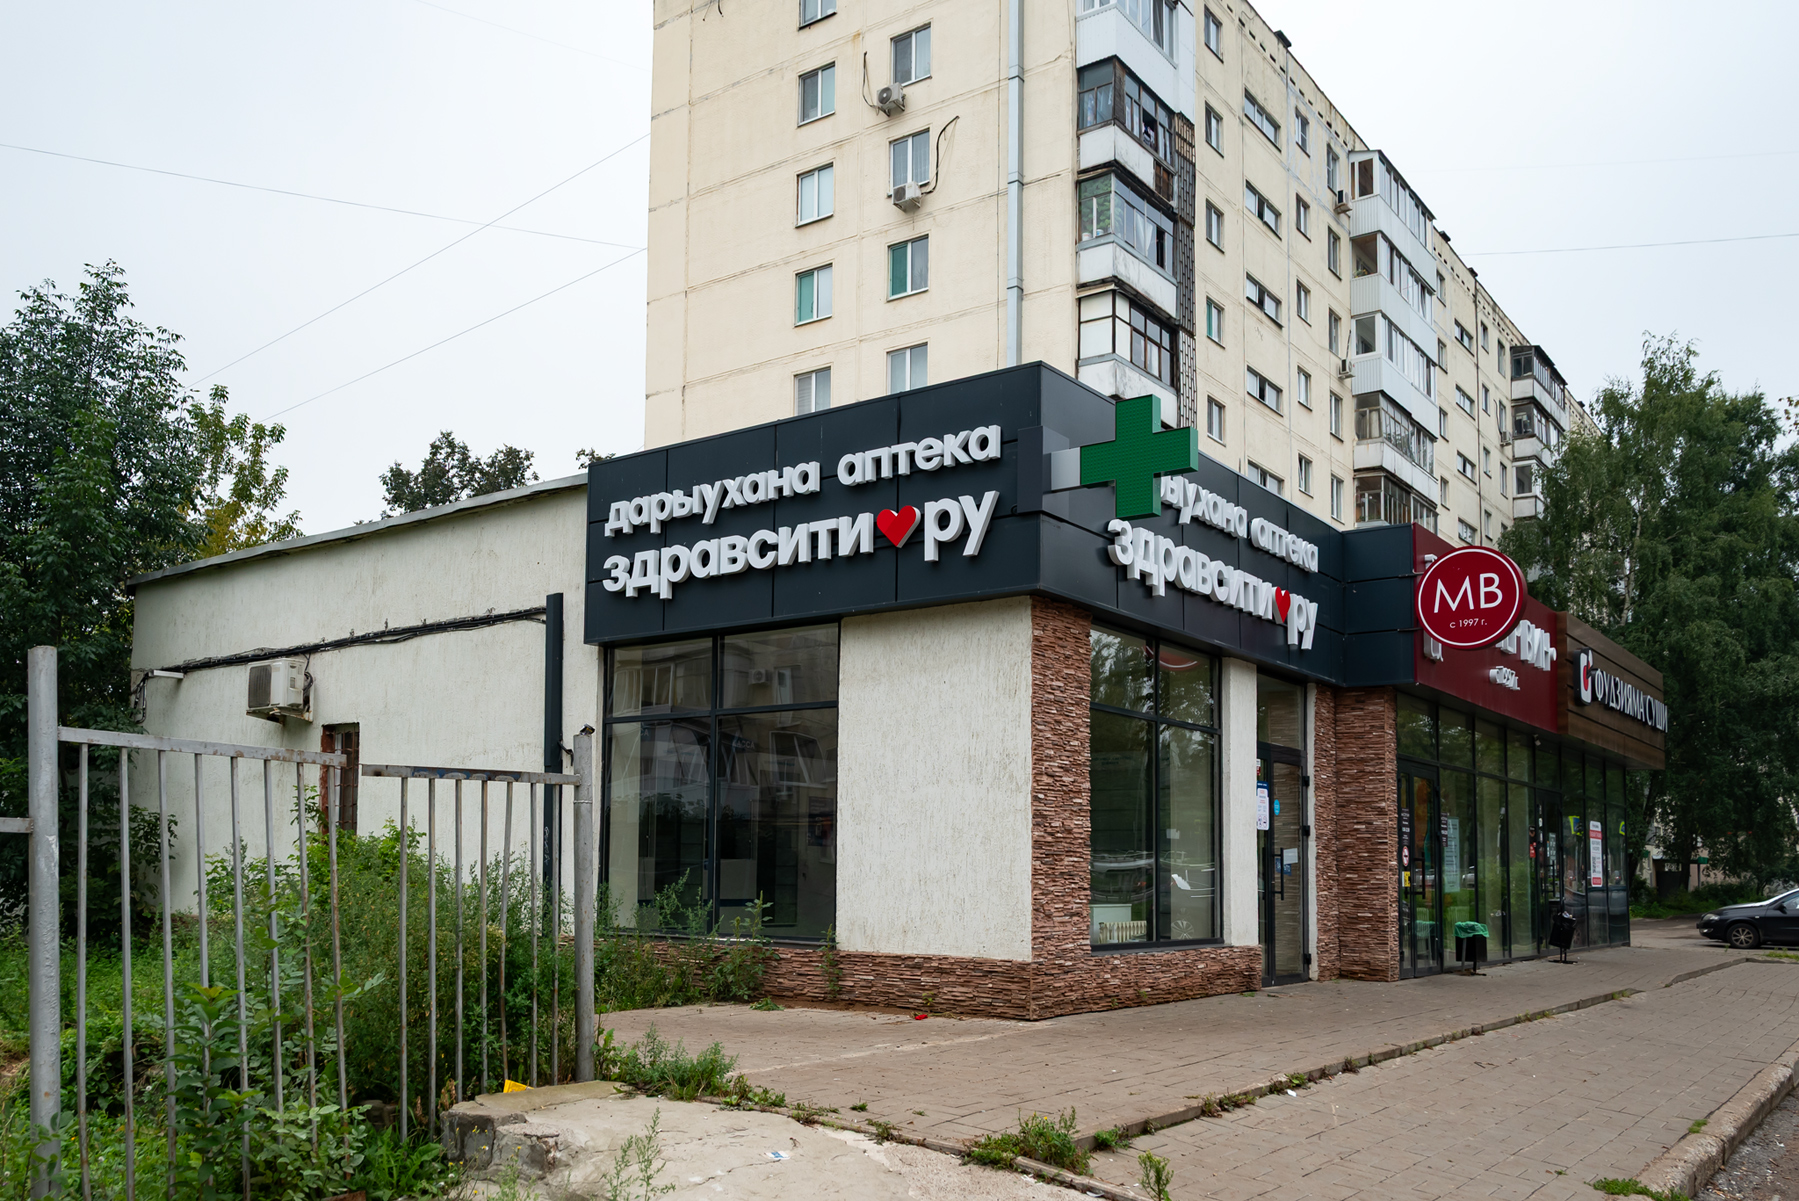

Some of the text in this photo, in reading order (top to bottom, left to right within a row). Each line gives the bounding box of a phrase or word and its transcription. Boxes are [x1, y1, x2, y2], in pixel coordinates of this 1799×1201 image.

[604, 424, 1001, 537] дарыухана аптека
[602, 511, 874, 599] здравсити
[1160, 475, 1319, 573] ыухана аптека
[1433, 572, 1503, 614] МВ
[1459, 618, 1479, 628] 1997
[1594, 668, 1668, 733] ФУДЗИЯМА СУШИ
